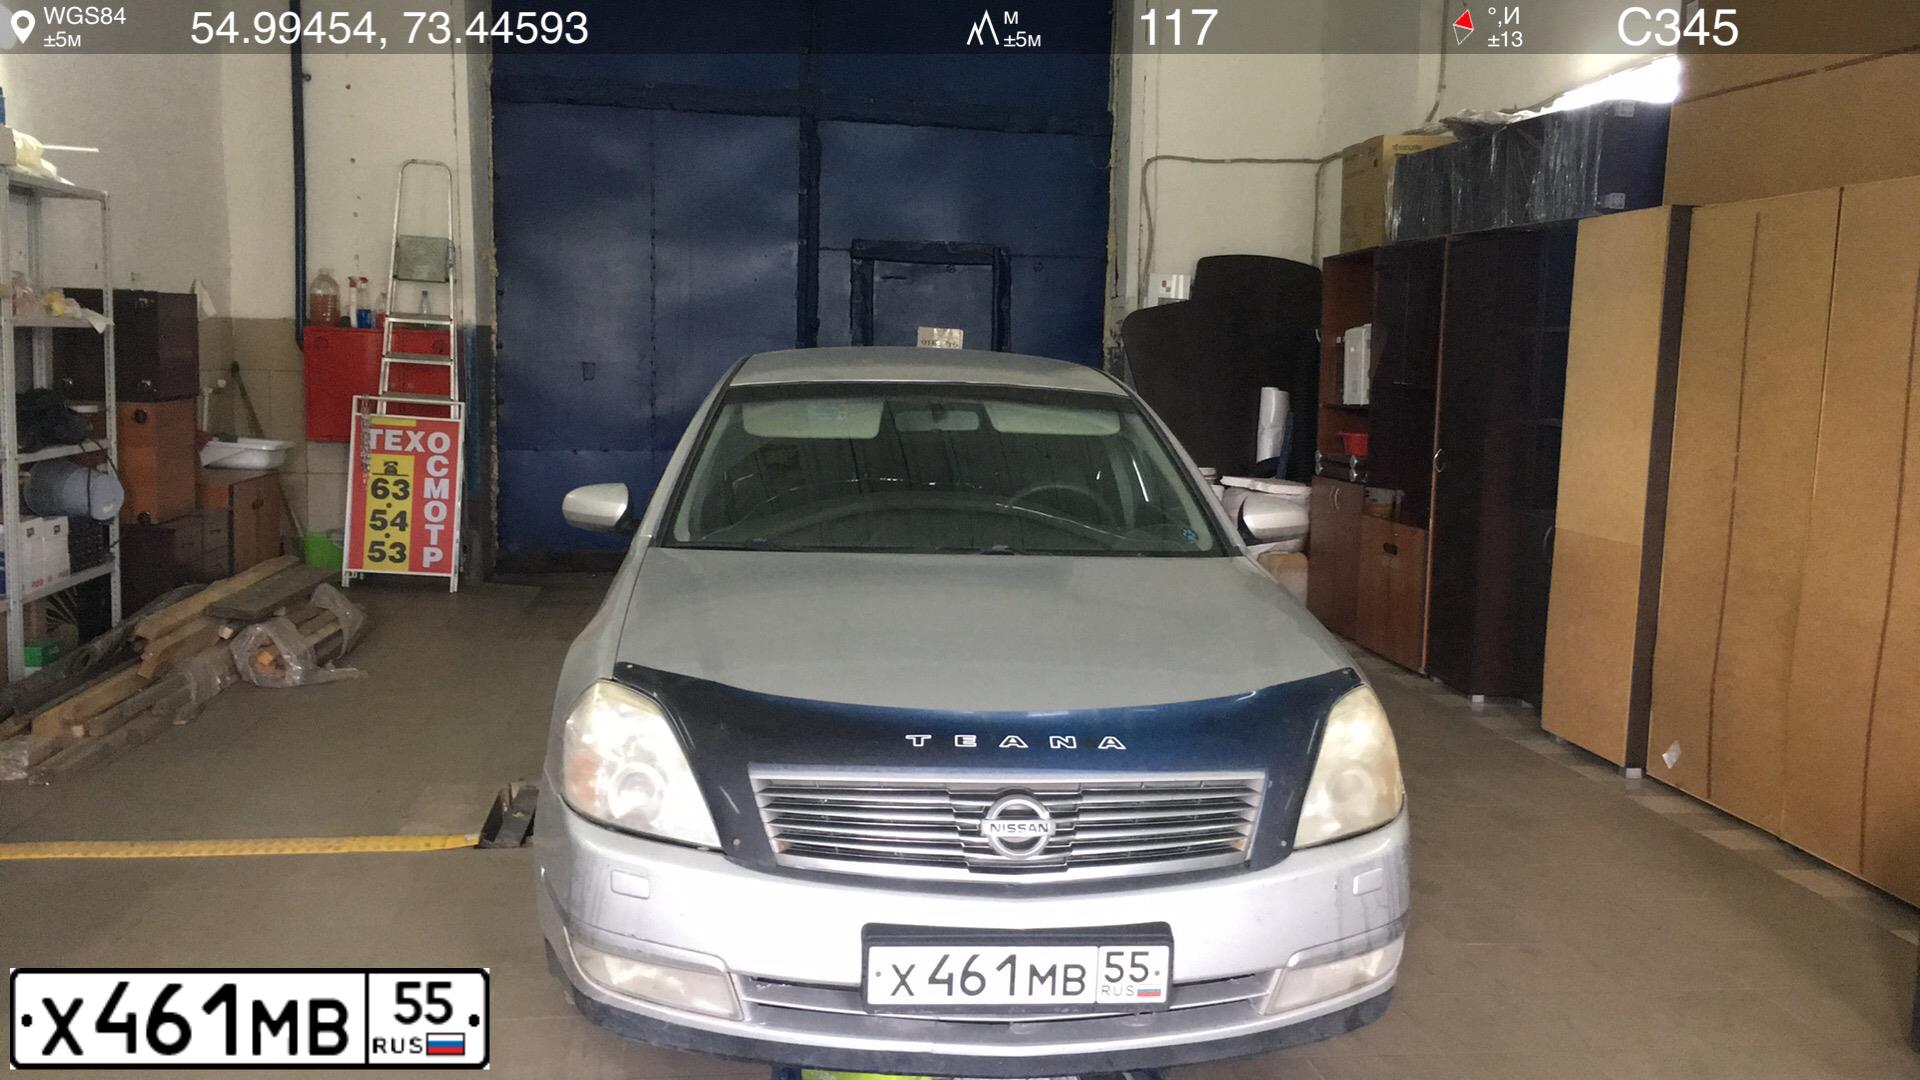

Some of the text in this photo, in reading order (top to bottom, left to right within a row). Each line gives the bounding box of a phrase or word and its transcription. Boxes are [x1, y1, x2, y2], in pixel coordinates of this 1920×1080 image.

[370, 477, 410, 501] 63
[368, 508, 408, 532] 54
[367, 540, 407, 564] 53
[905, 734, 1127, 750] TEANA
[990, 823, 1048, 834] NISSAN
[1101, 984, 1135, 998] RUS
